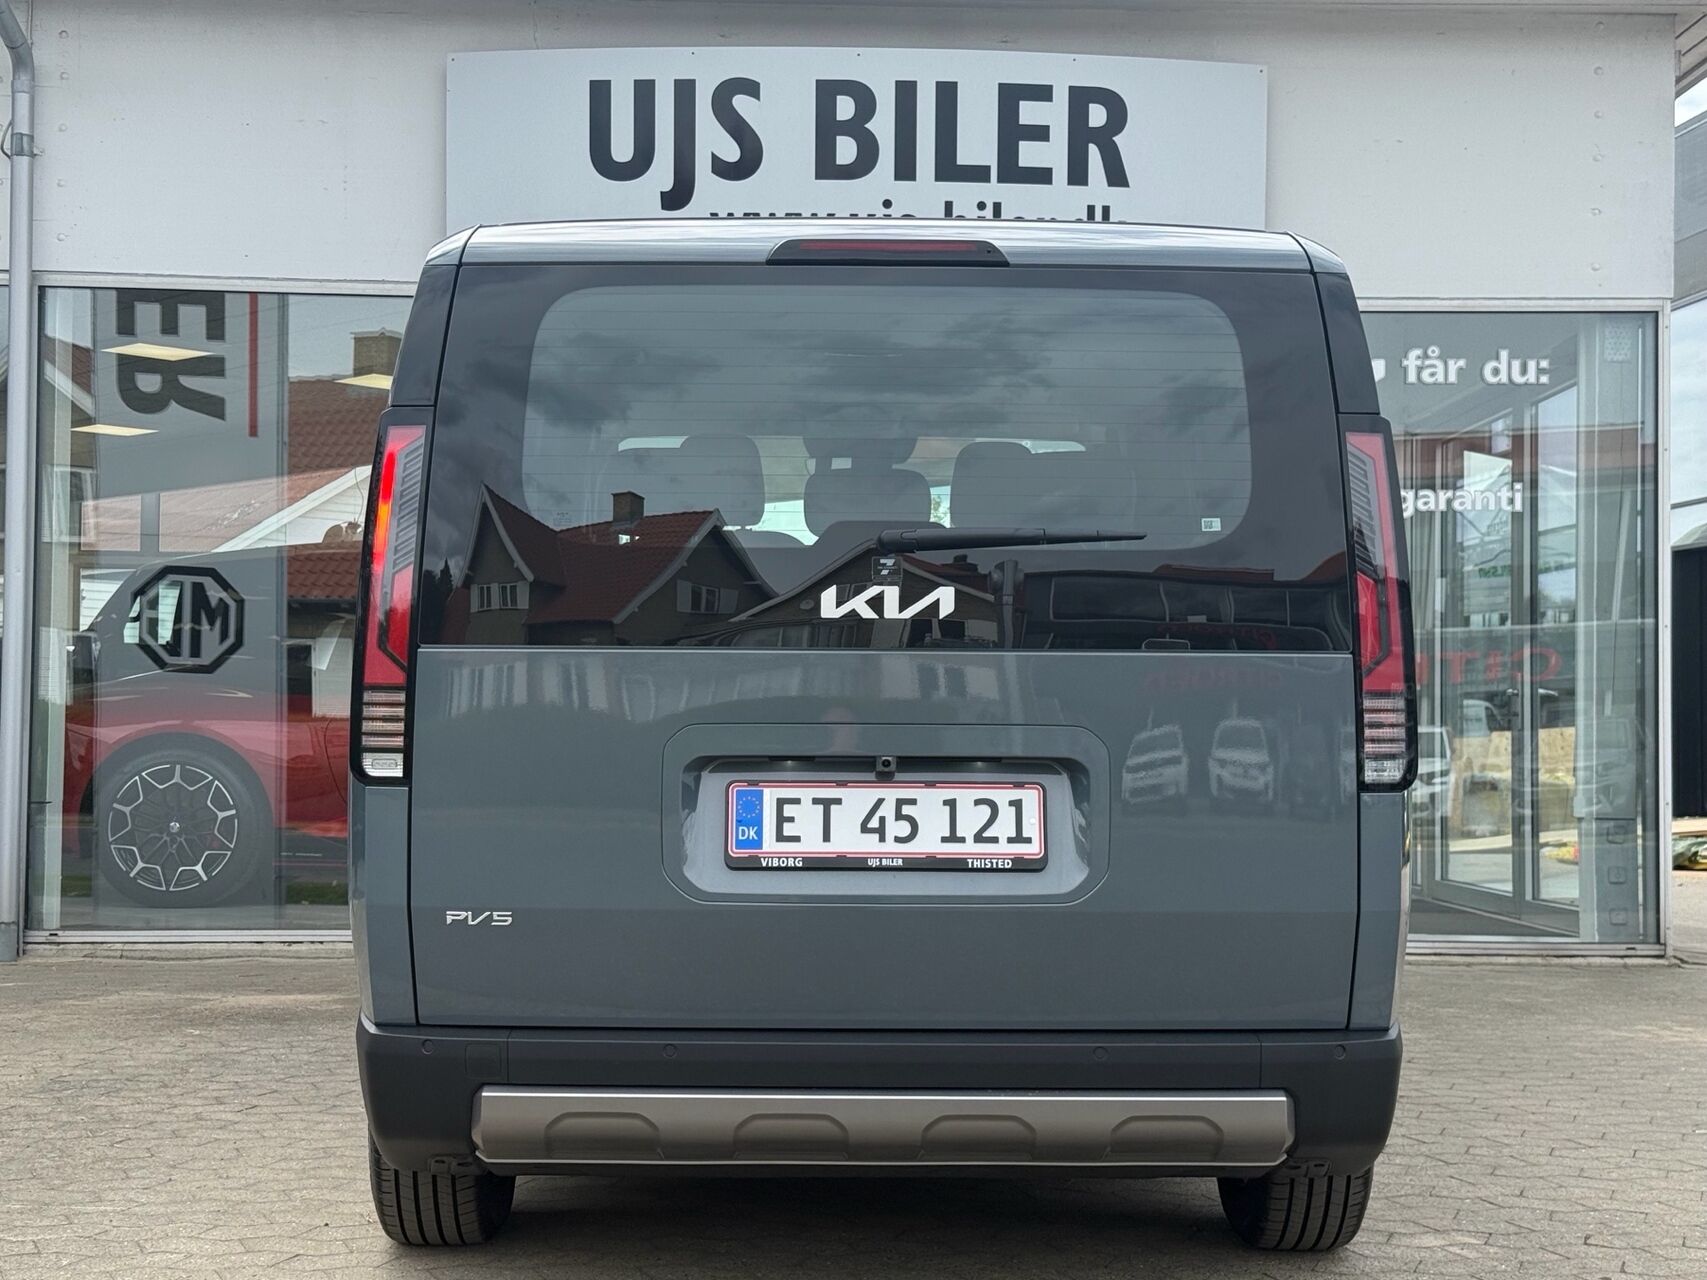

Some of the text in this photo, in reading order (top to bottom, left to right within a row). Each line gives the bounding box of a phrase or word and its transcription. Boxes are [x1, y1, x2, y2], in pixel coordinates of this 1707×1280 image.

[589, 77, 1131, 211] UJS BILER
[1401, 345, 1466, 385] får
[1482, 349, 1550, 385] du:
[819, 584, 955, 621] KIA
[776, 797, 1032, 845] ET 45 121
[738, 825, 759, 841] DK
[760, 857, 803, 867] VIBORG
[867, 857, 903, 868] UJS BILER
[967, 859, 1012, 869] THISTED
[446, 911, 513, 926] PV5
